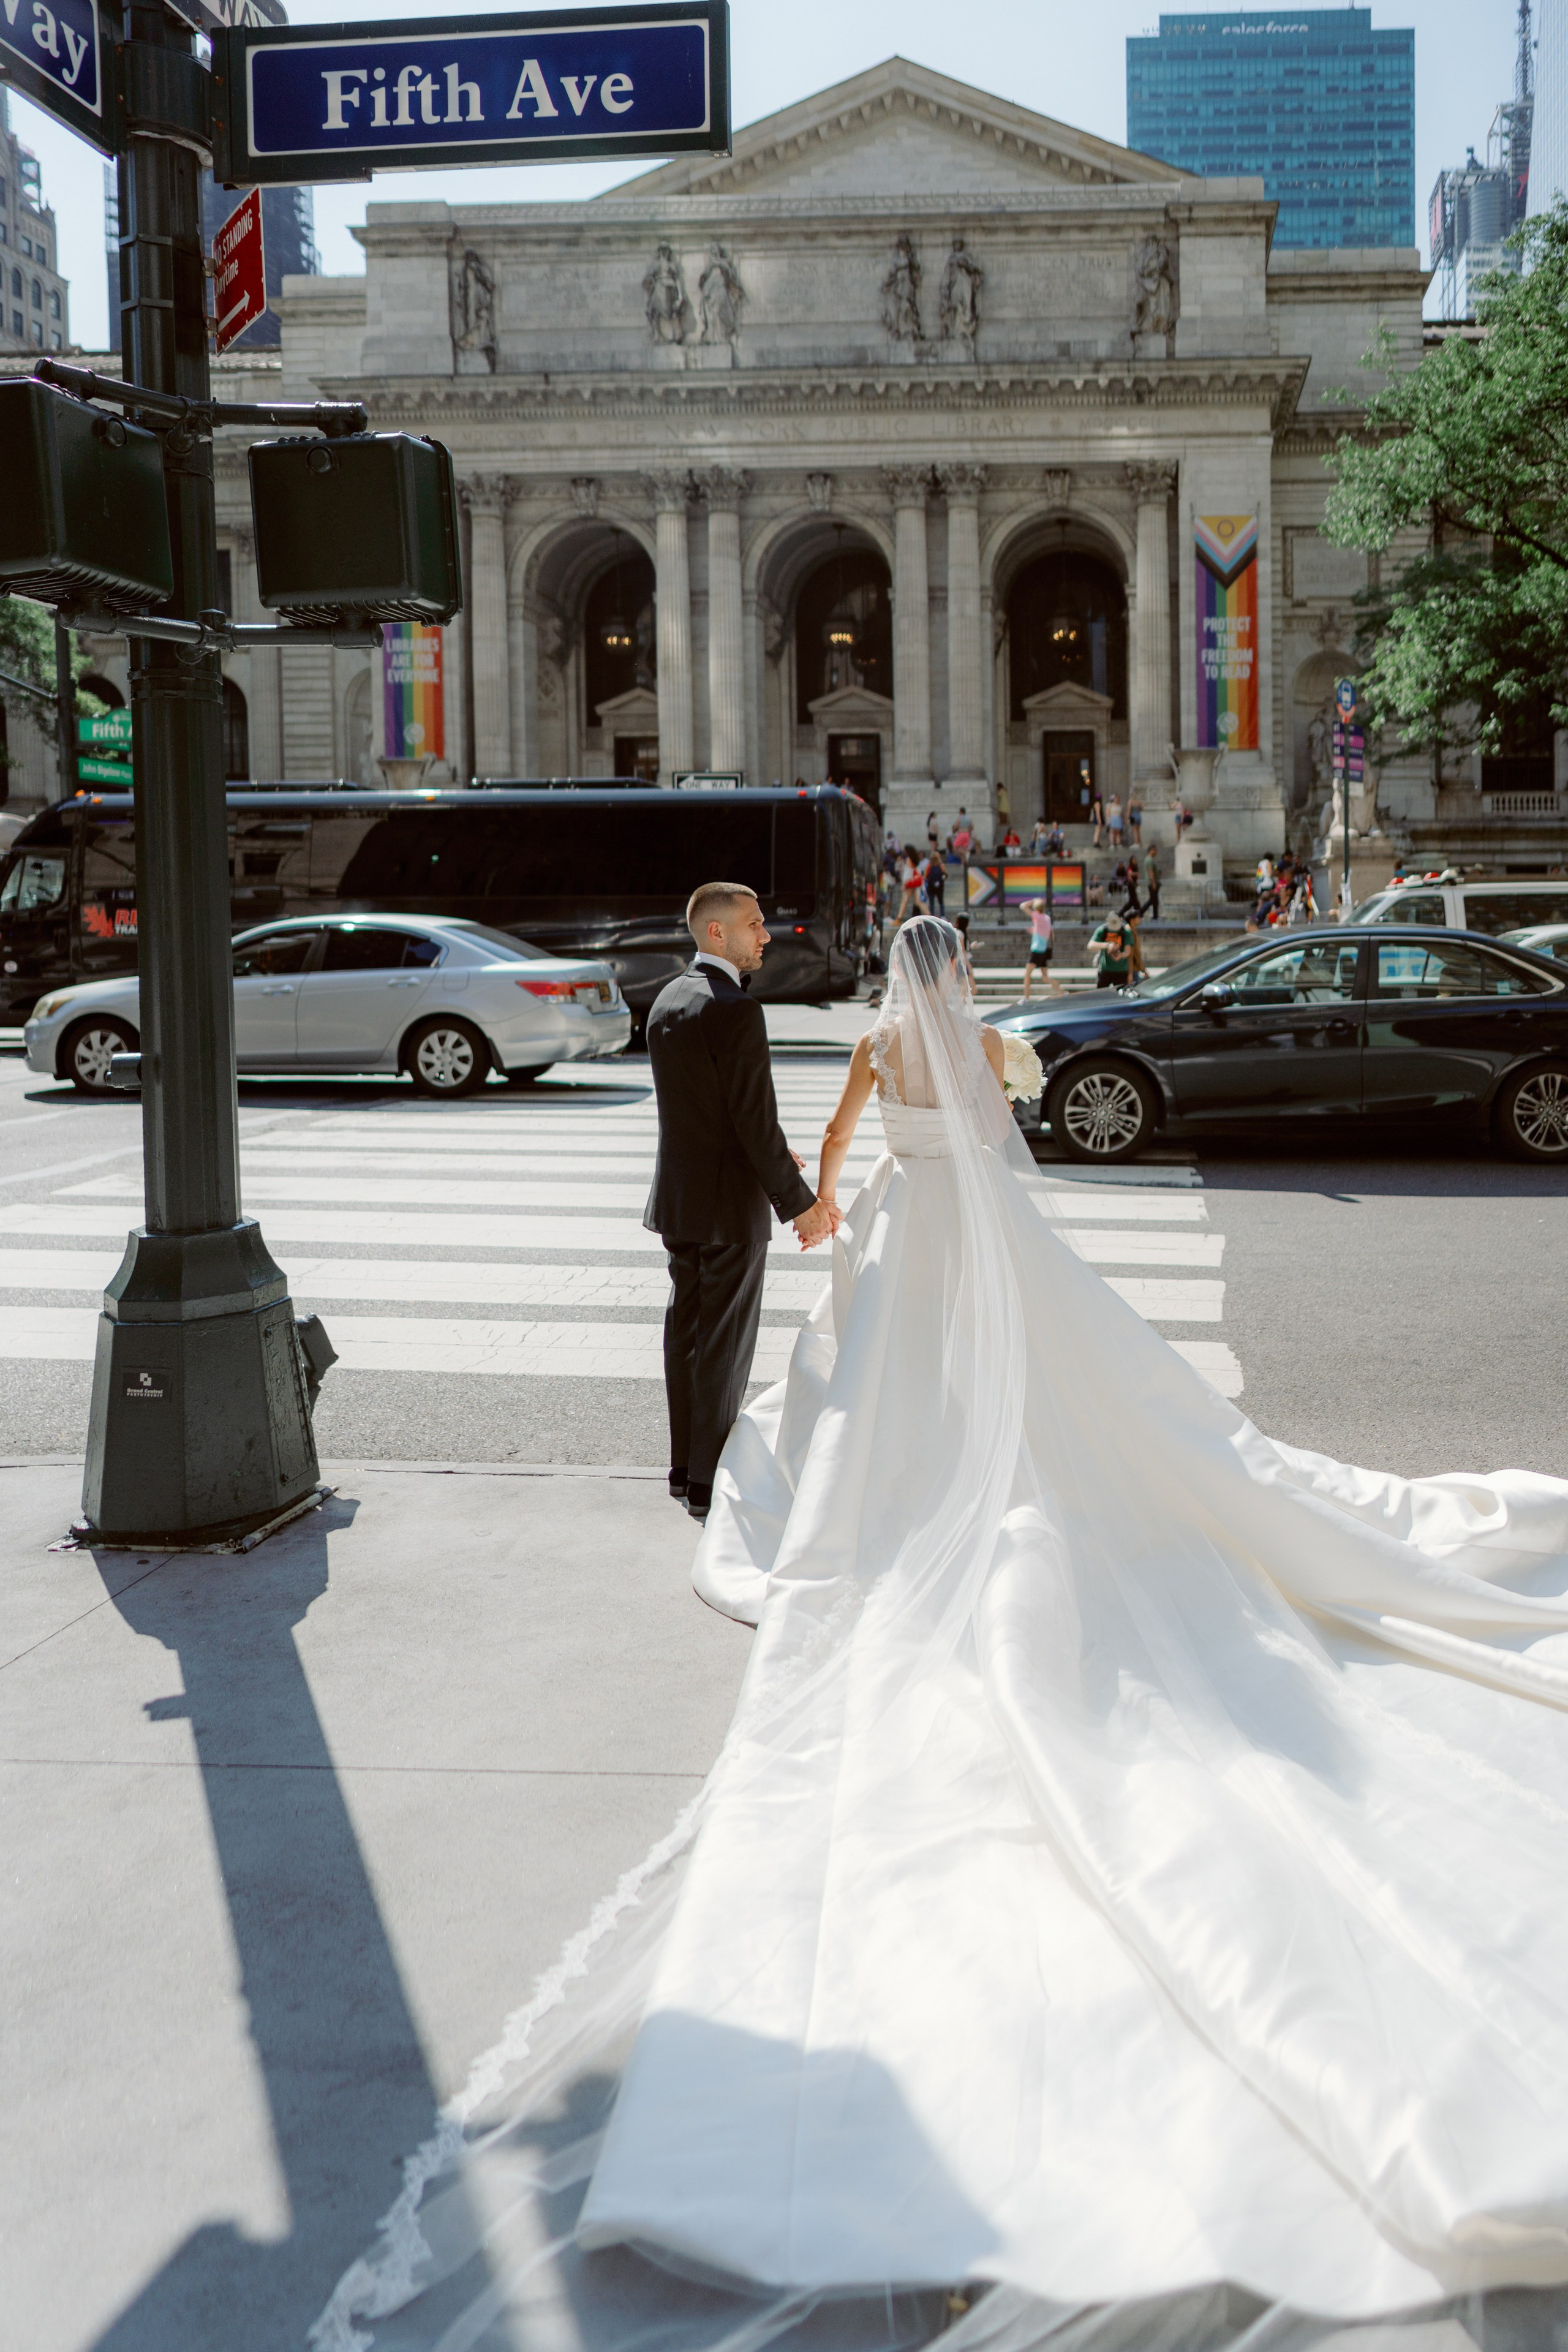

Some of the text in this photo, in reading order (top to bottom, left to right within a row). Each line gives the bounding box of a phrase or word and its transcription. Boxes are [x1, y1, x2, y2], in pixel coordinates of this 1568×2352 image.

[321, 59, 634, 130] Fifth Ave
[214, 208, 253, 268] NO STANDING
[216, 258, 238, 298] Anytime
[597, 423, 646, 442] THE
[665, 421, 725, 440] NEW
[745, 420, 805, 440] YORK
[826, 418, 909, 437] PUBLIC
[932, 416, 1030, 435] LIBRARY
[1203, 616, 1251, 632] PROTECT
[386, 638, 439, 652] LIBRARIES
[1216, 633, 1237, 647] THE
[391, 653, 434, 668] ARE FOR
[1201, 648, 1253, 664] FREEDOM
[386, 668, 439, 684] EVERYONE
[1204, 664, 1251, 680] TO READ
[92, 722, 124, 739] Fifth
